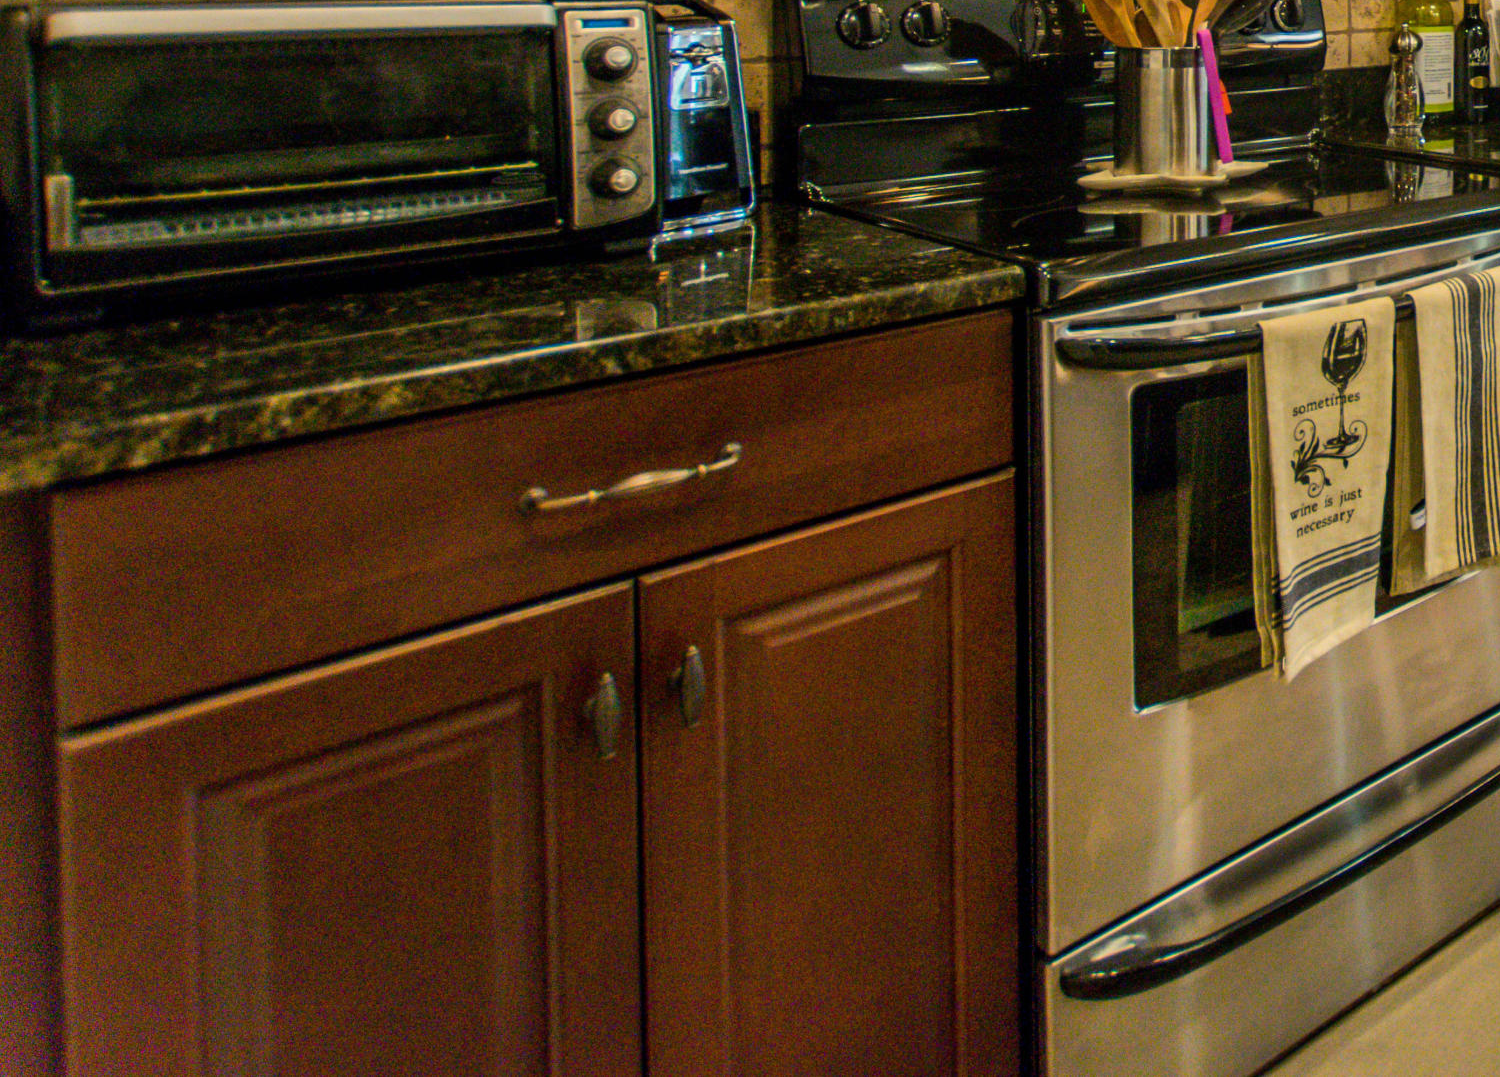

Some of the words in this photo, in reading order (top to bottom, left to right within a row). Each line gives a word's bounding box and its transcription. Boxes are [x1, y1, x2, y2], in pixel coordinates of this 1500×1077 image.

[1292, 391, 1361, 417] sometimes
[1290, 502, 1318, 521] wine
[1324, 494, 1334, 508] is
[1339, 487, 1363, 508] just
[1296, 508, 1356, 539] necessary
